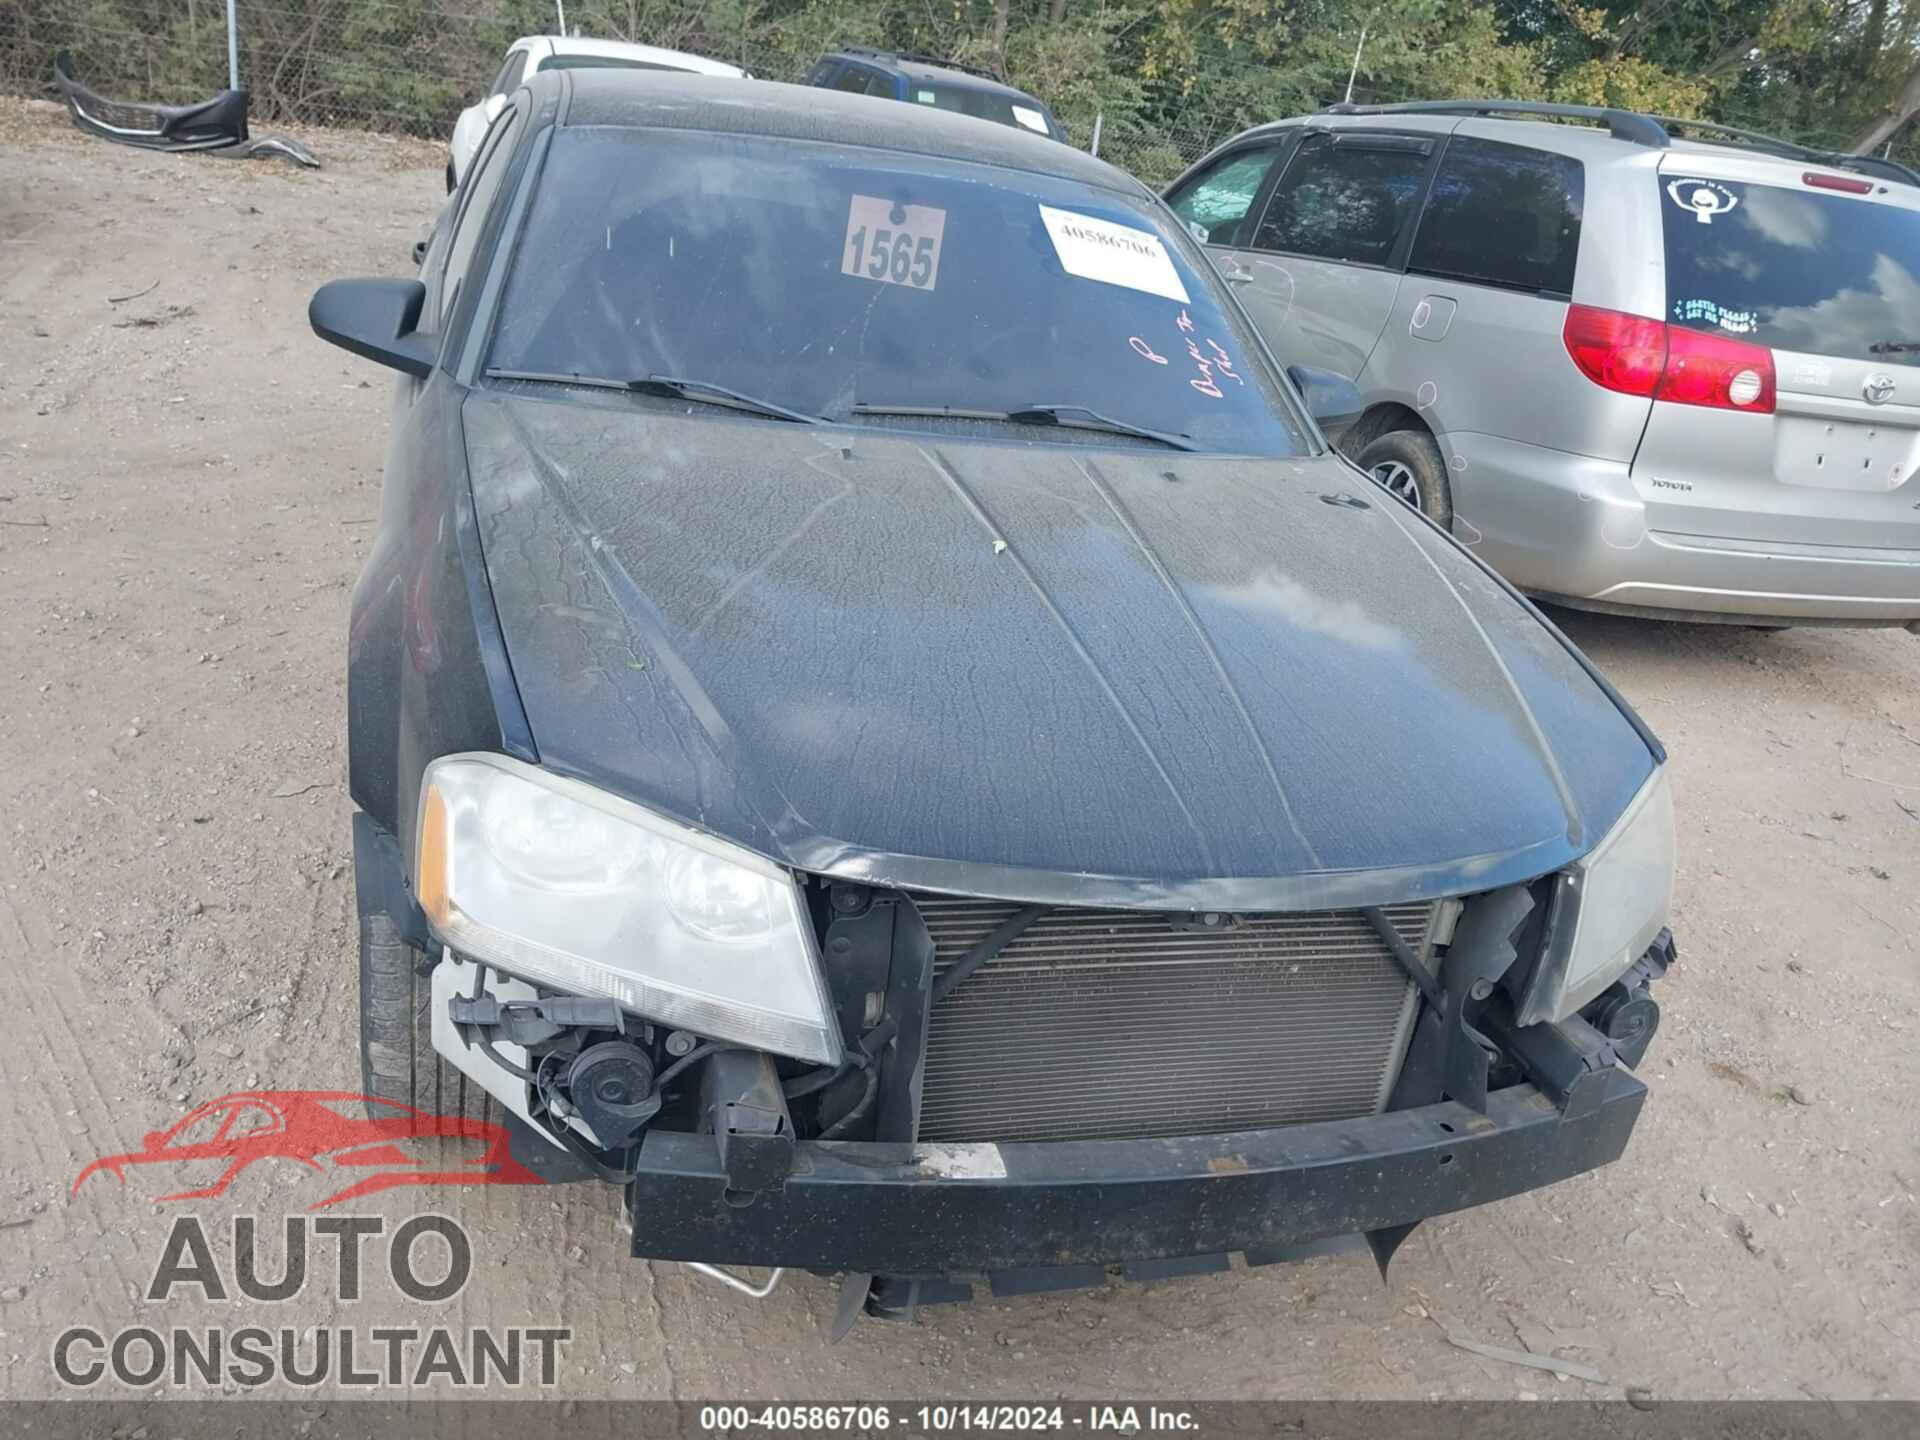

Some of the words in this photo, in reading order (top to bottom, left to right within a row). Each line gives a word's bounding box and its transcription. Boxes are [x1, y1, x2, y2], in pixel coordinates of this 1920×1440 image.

[852, 225, 935, 288] 1565
[1061, 224, 1157, 258] 40586706
[1651, 479, 1692, 491] TOYOTA
